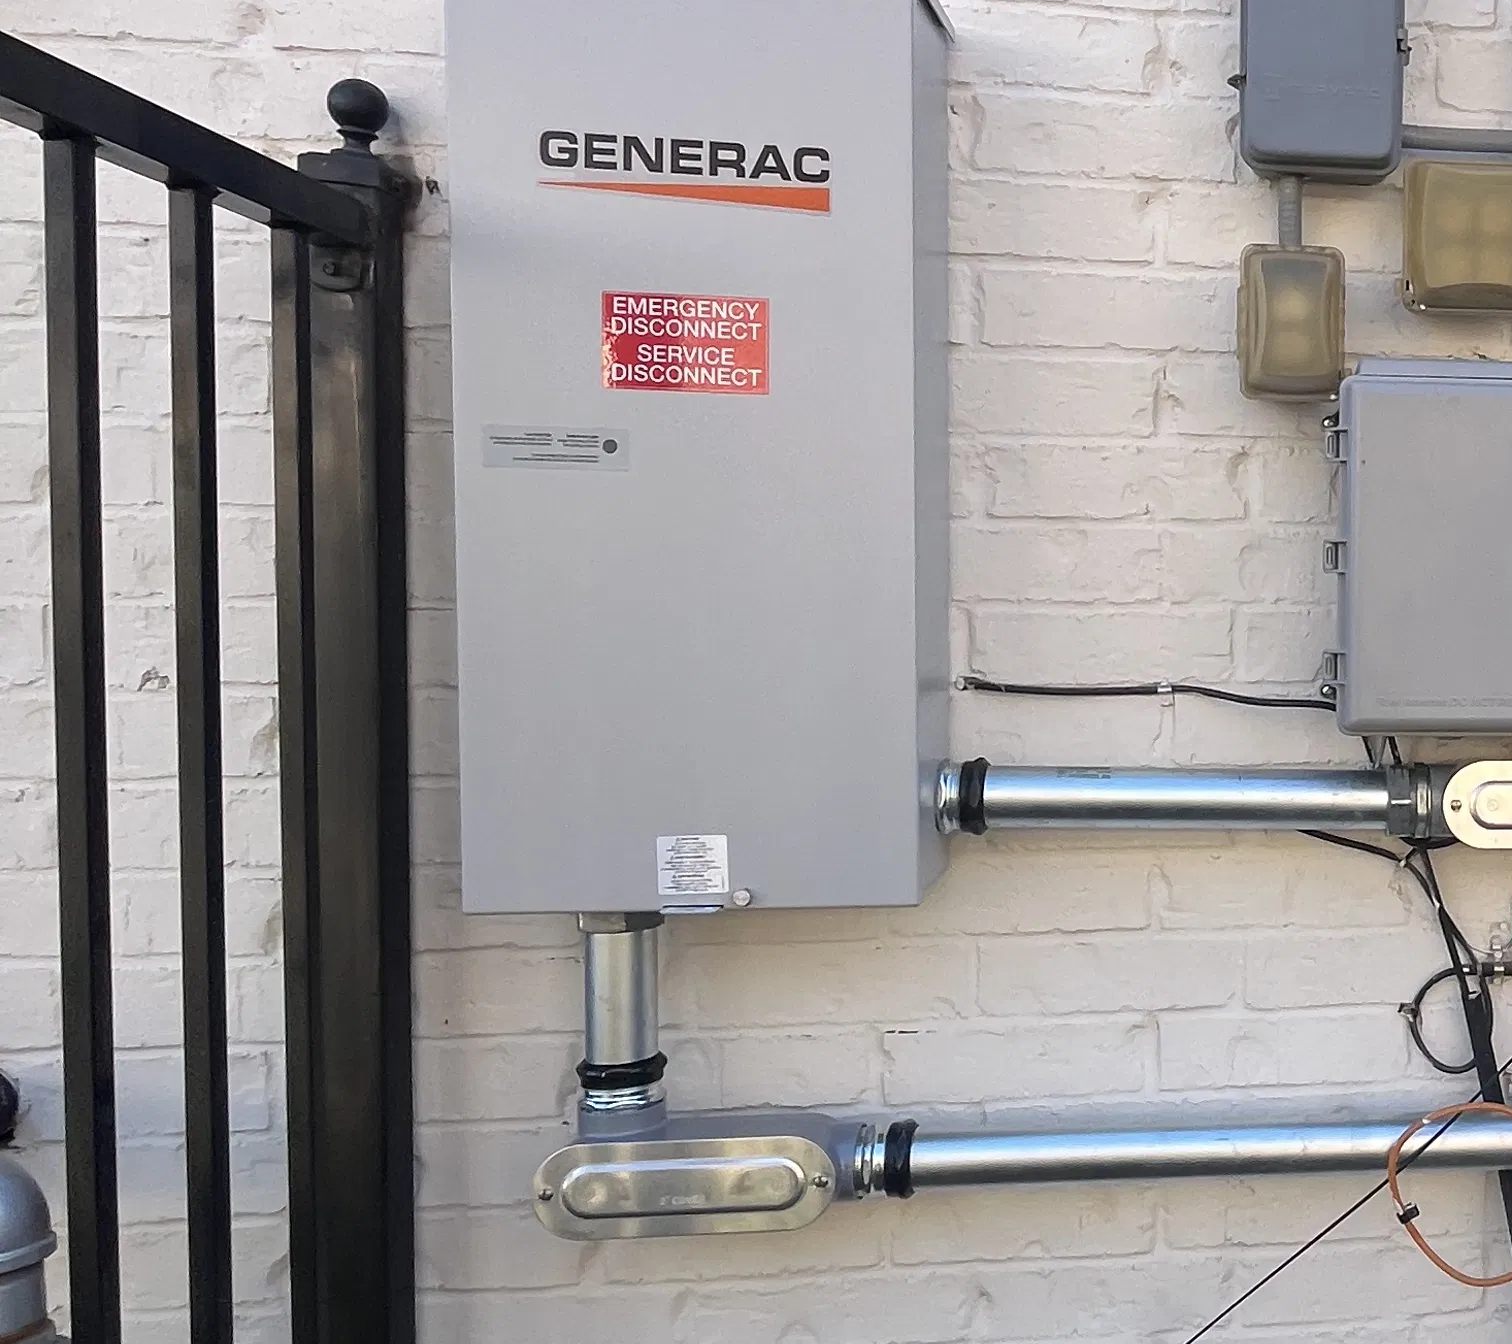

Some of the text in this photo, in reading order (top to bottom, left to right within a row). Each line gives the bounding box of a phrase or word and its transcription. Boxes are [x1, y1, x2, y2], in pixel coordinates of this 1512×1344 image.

[539, 129, 832, 184] GENERAC
[612, 296, 760, 321] EMERGENCY
[611, 316, 763, 341] DISCONNECT
[637, 343, 736, 366] SERVICE
[611, 363, 763, 387] DISCONNECT
